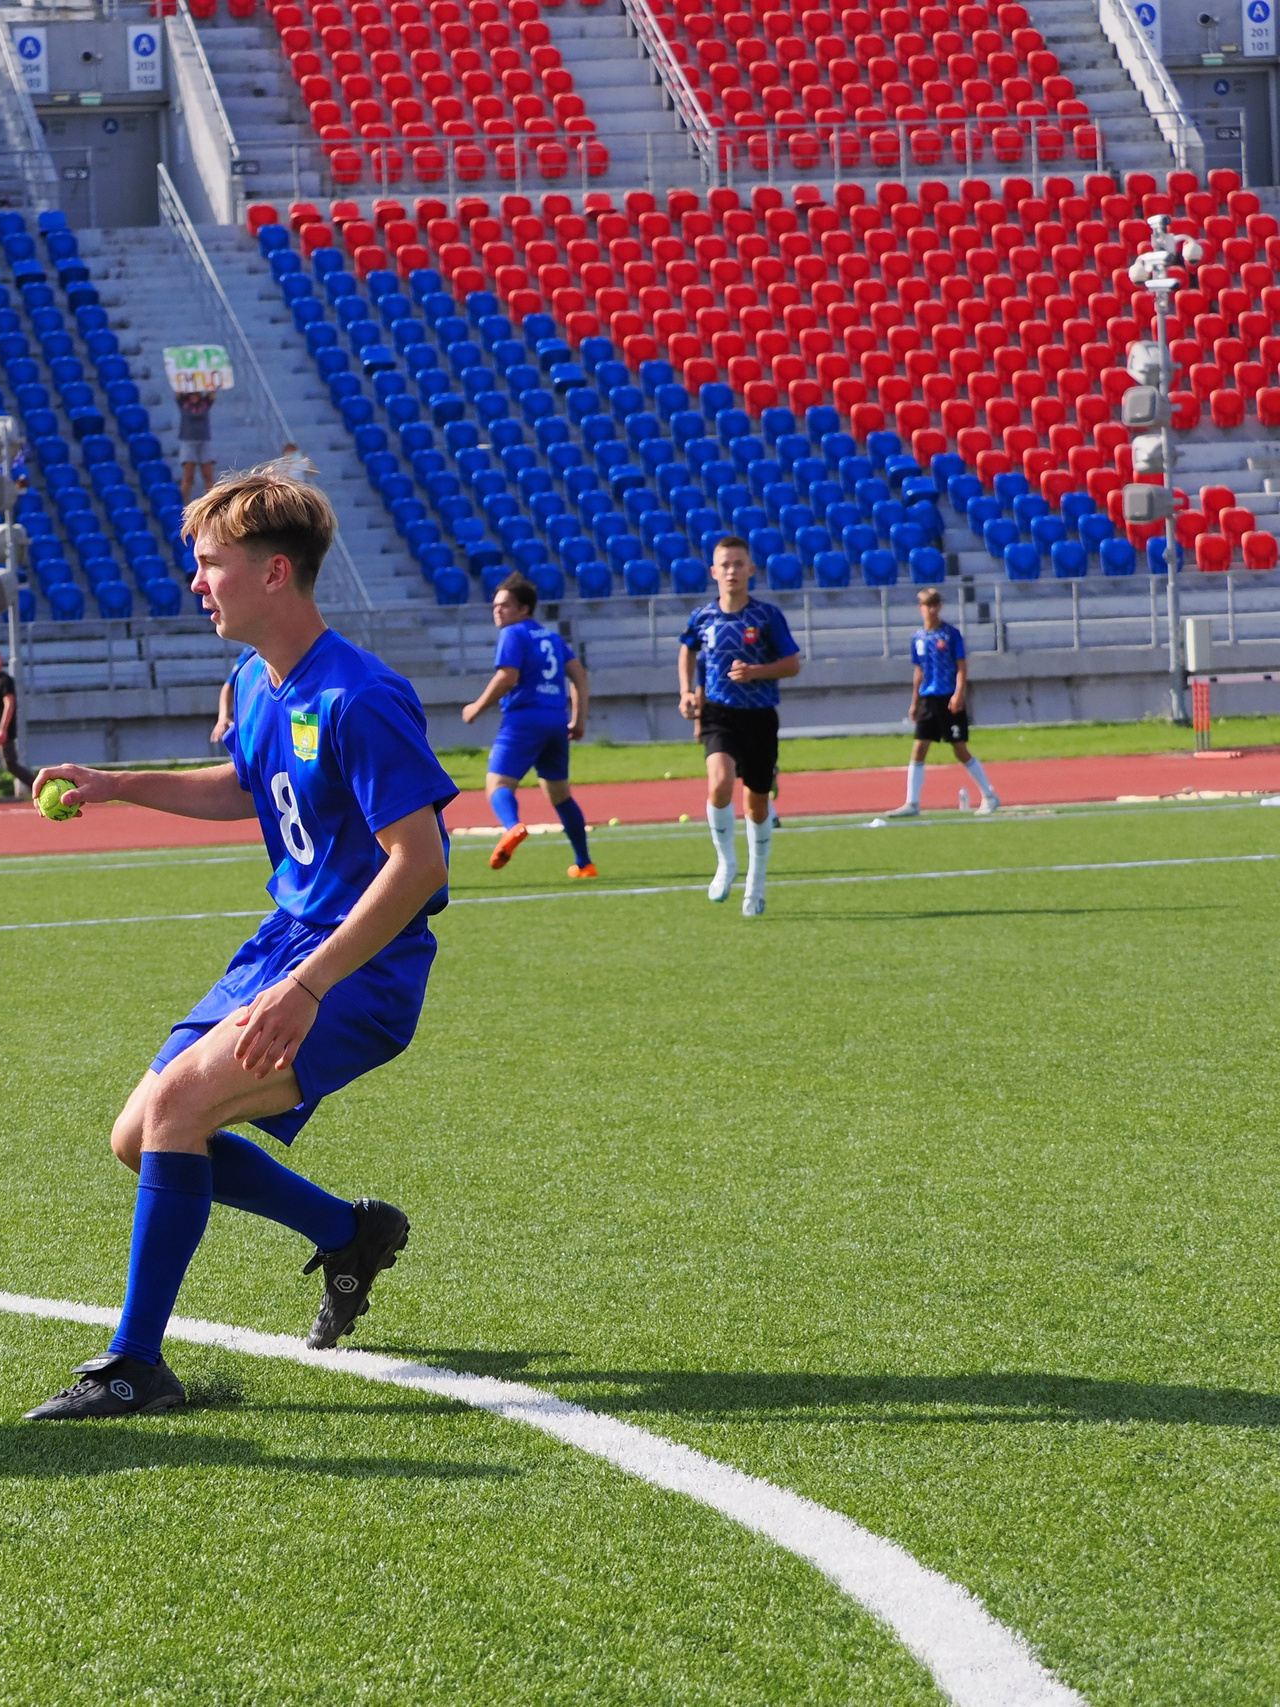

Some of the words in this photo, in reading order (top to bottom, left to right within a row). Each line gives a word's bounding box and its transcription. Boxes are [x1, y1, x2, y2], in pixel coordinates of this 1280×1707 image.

[1250, 28, 1269, 38] 201
[1251, 41, 1269, 51] 101
[704, 624, 716, 649] 1
[540, 638, 558, 680] 3
[271, 771, 315, 866] 8
